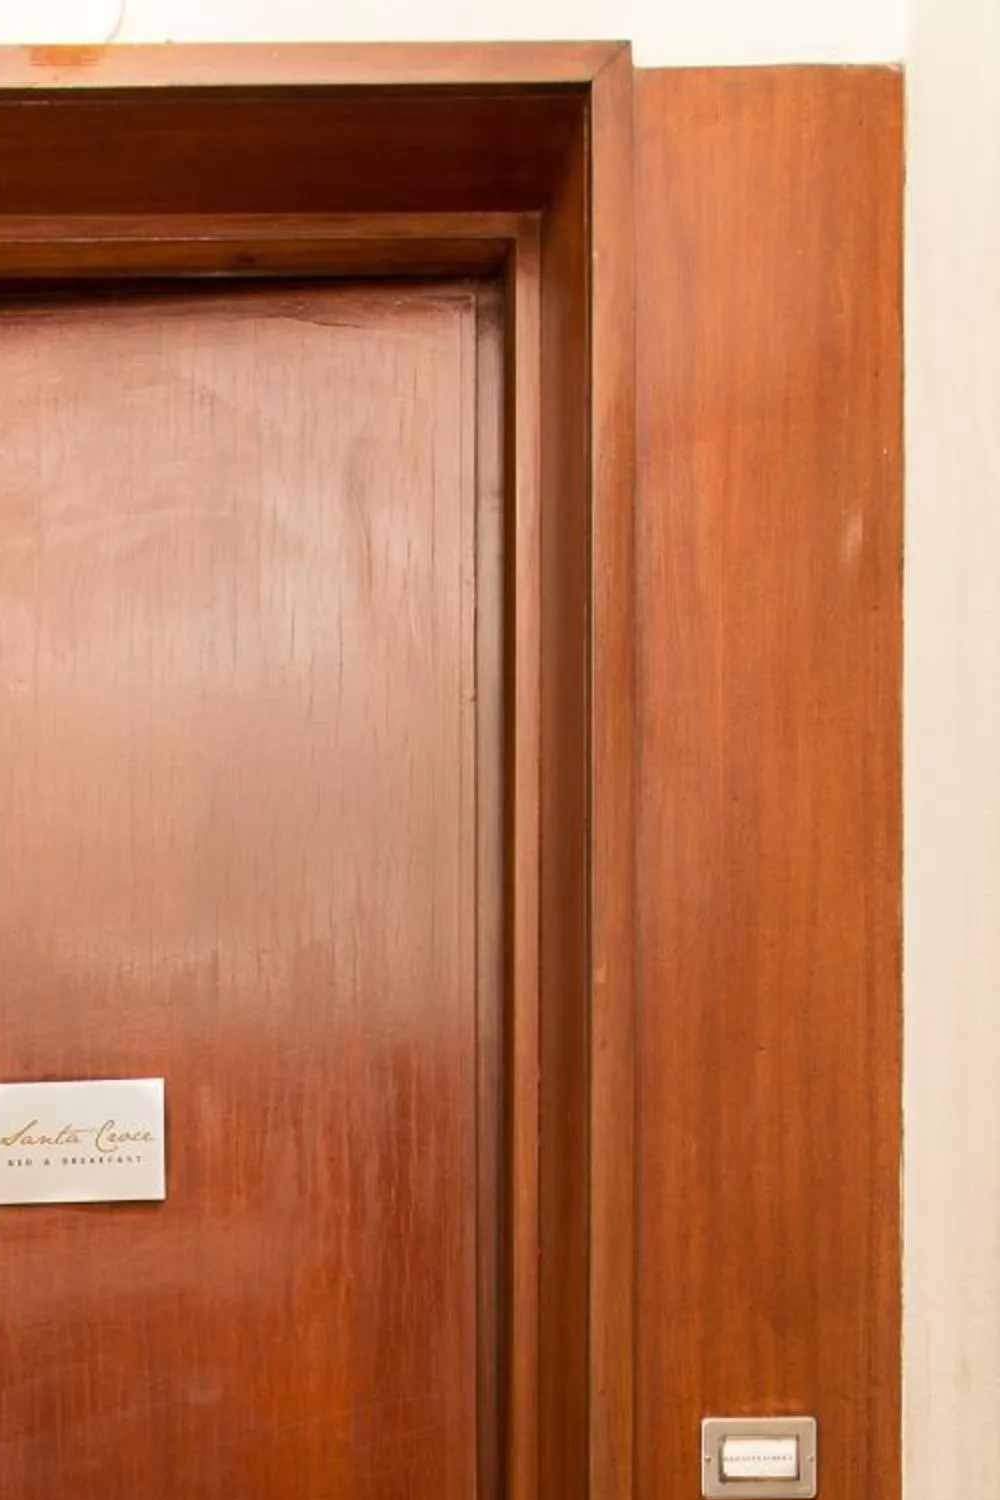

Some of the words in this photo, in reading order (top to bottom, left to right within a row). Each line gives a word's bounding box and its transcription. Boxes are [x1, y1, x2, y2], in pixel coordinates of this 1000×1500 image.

[95, 1119, 154, 1153] Croce
[7, 1158, 33, 1167] BED
[44, 1157, 51, 1166] &
[61, 1155, 143, 1166] BREAKFAST
